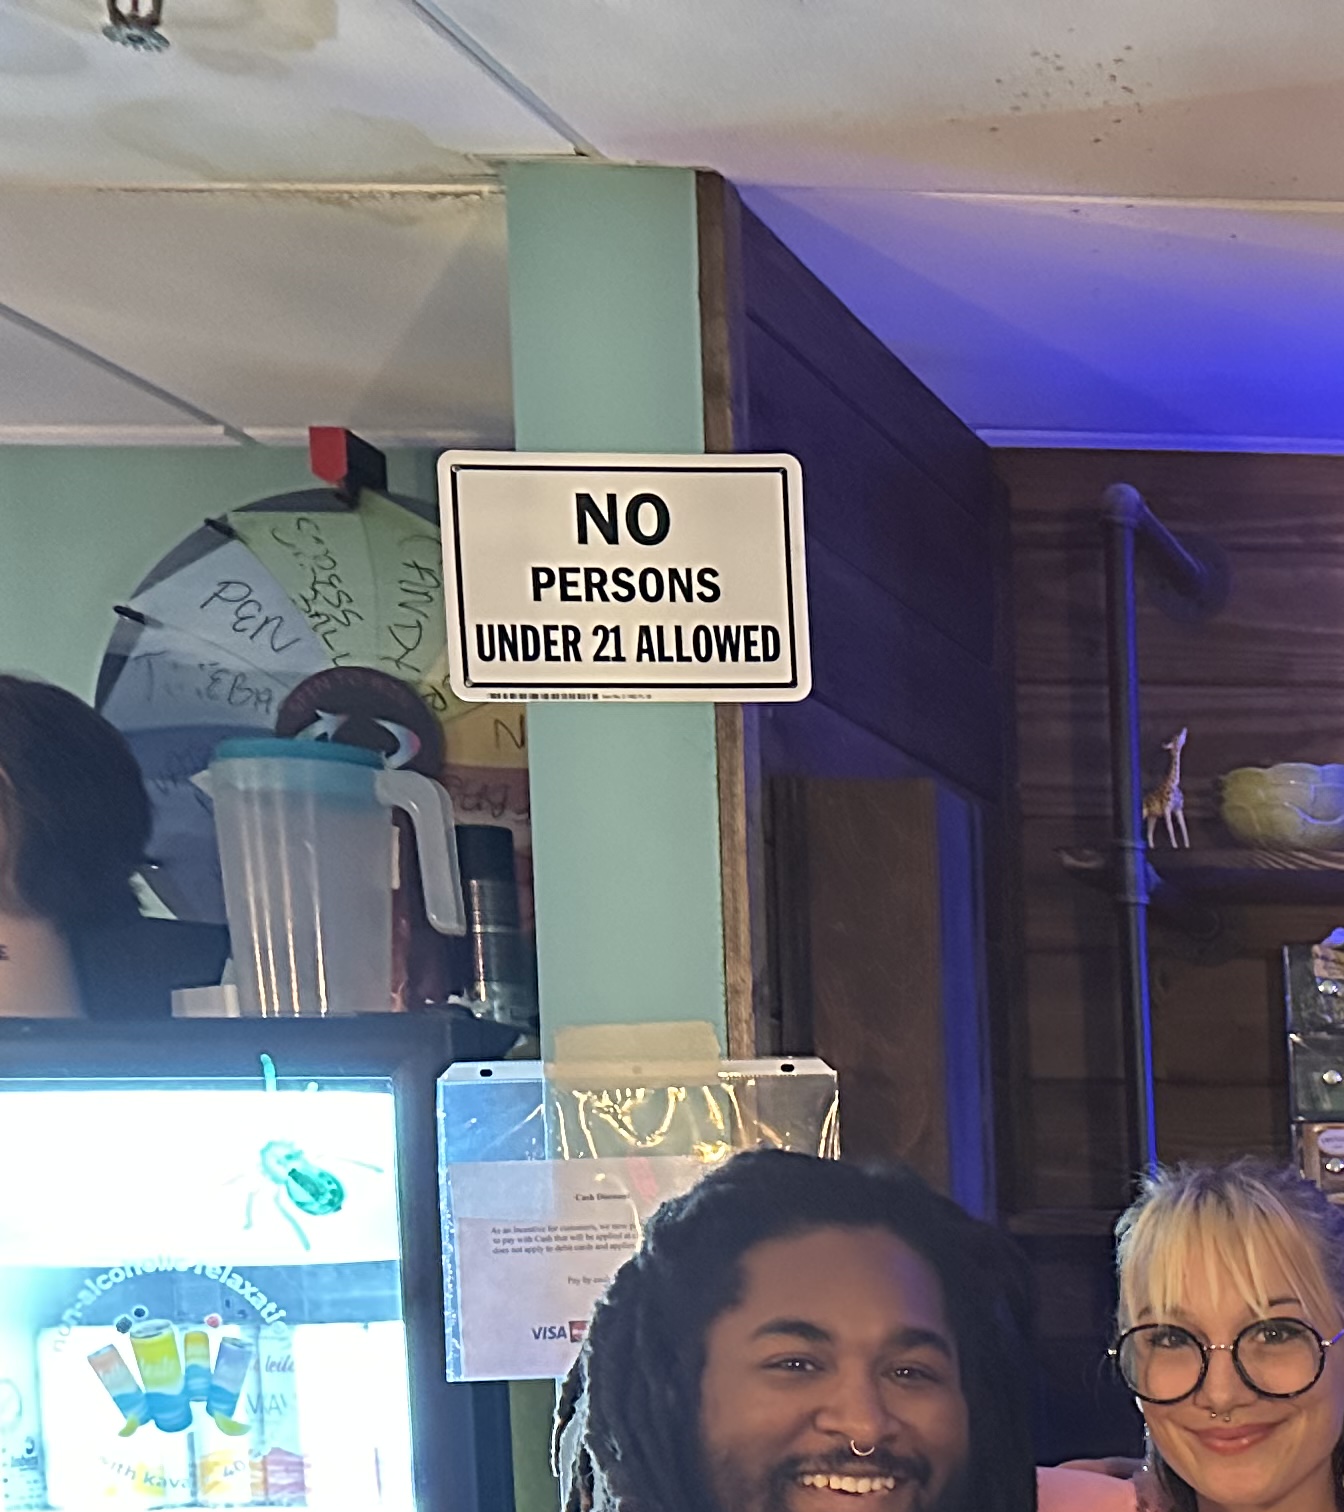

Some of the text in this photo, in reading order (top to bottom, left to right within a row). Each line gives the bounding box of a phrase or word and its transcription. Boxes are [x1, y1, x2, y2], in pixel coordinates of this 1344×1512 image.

[575, 493, 671, 546] NO
[531, 567, 722, 603] PERSONS
[201, 581, 301, 652] PEN
[475, 624, 780, 663] UNDER 21 ALLOWED
[194, 1260, 288, 1335] relaxatio
[531, 1326, 567, 1340] VISA
